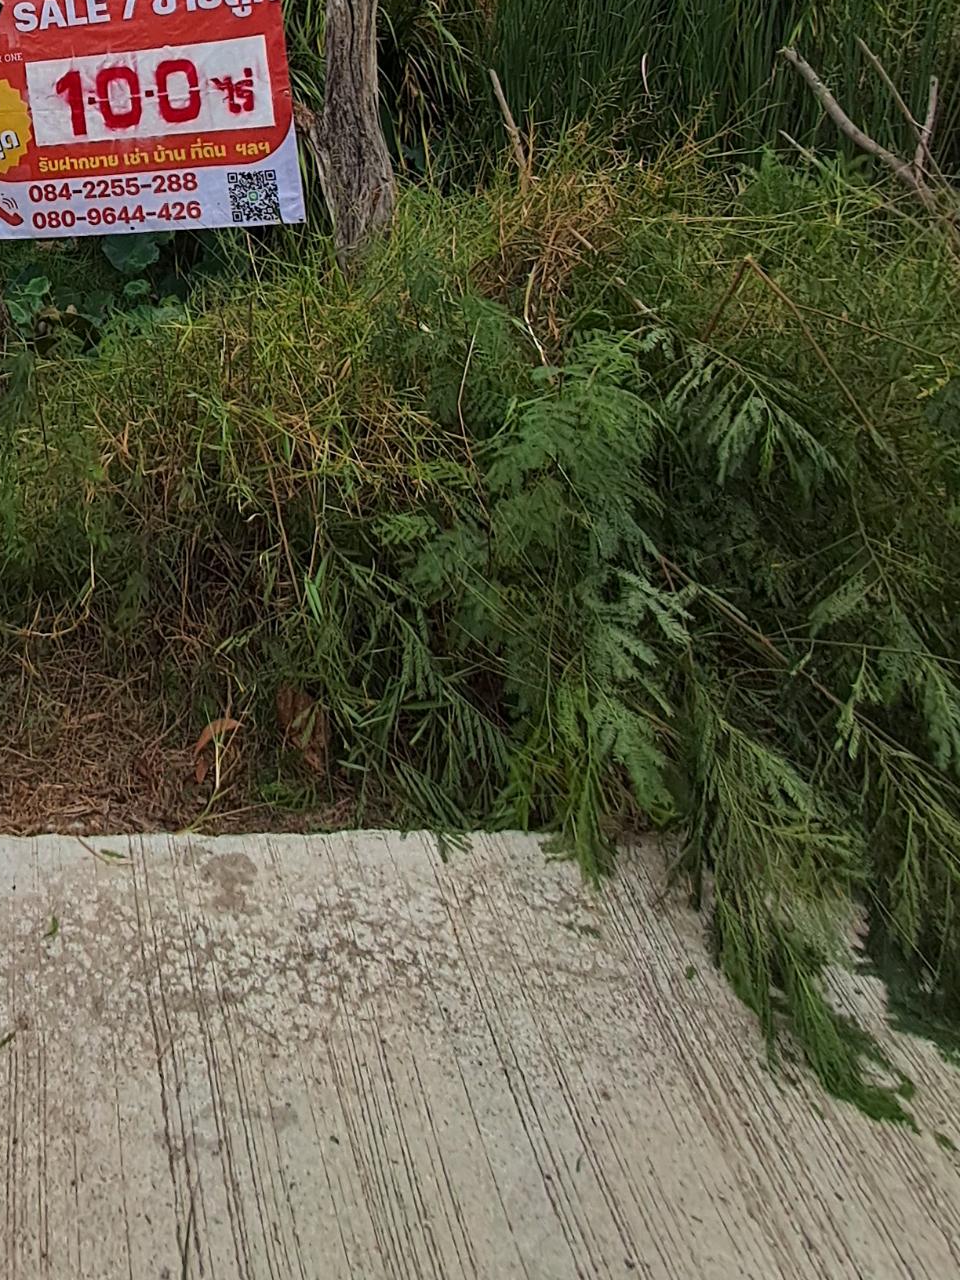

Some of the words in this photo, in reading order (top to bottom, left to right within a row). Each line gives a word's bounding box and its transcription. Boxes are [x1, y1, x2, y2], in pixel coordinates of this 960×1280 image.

[5, 52, 23, 62] ONE
[38, 153, 119, 174] รับฝากขาย
[124, 147, 149, 166] เช่า
[153, 144, 186, 162] บ้าน
[191, 138, 226, 160] ที่ดิน
[236, 141, 270, 158] ฯลฯ
[29, 173, 198, 203] 084-2255-288
[32, 201, 202, 230] 080-9644-426
